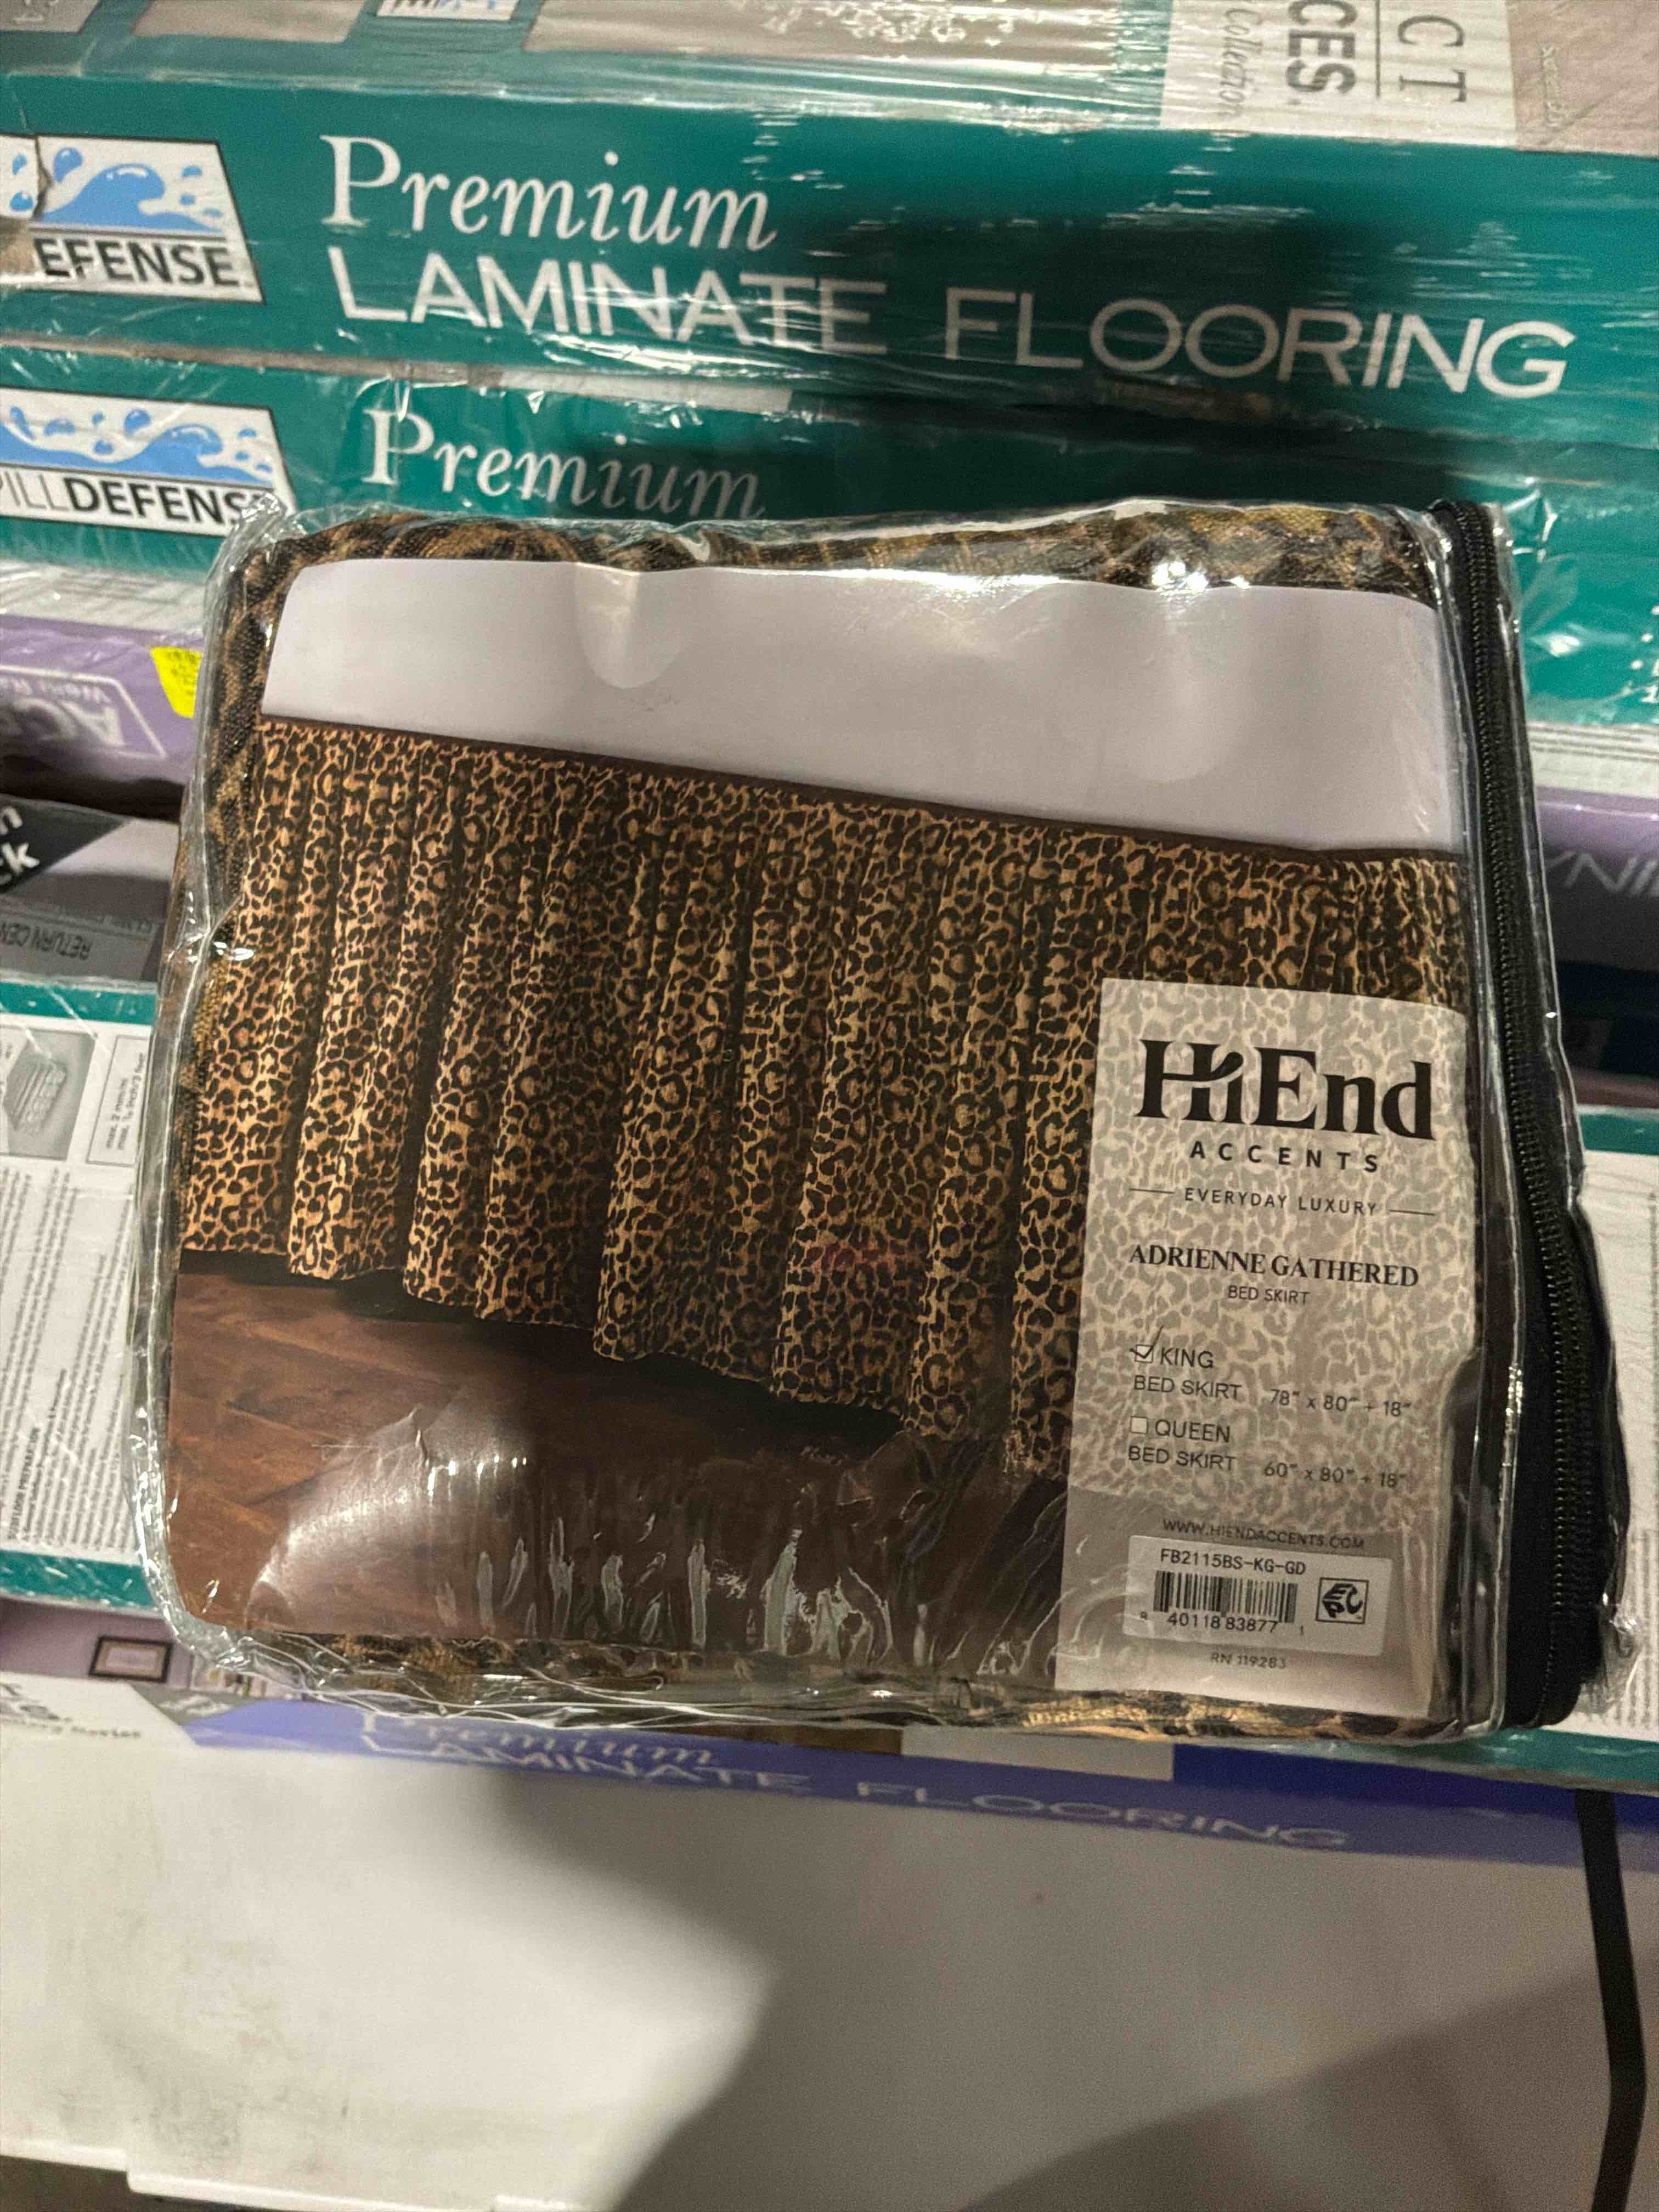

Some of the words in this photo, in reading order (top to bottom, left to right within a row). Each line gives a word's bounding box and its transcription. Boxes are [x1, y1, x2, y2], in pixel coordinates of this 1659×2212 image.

[321, 134, 777, 252] Premium
[328, 246, 888, 355] LAMINATE
[945, 286, 1577, 399] FLOORING
[360, 408, 766, 520] Premium
[0, 471, 264, 524] ILLDEFENS
[1190, 1141, 1378, 1173] ACCENTS
[1184, 1187, 1288, 1208] EVERYDAY
[1298, 1197, 1378, 1216] LUXURY
[1129, 1244, 1266, 1274] ADRIENNE
[1271, 1254, 1419, 1287] GATHERED
[1227, 1284, 1259, 1301] BED
[1263, 1288, 1311, 1305] SKIRT
[1160, 1346, 1214, 1369] KING
[1133, 1374, 1175, 1393] BED
[1180, 1379, 1243, 1400] SKIRT
[1306, 1398, 1316, 1409] x
[1154, 1419, 1231, 1443] QUEEN
[1127, 1445, 1170, 1464] BED
[1176, 1450, 1237, 1471] SKIRT
[1304, 1469, 1314, 1481] x
[1163, 1518, 1365, 1549] WWW.HIENDACCENTS.COM
[1160, 1548, 1307, 1575] FB2115BS-KG-GD
[1167, 1612, 1221, 1629] 40118
[1225, 1616, 1279, 1633] 83877
[1211, 1652, 1233, 1665] RN
